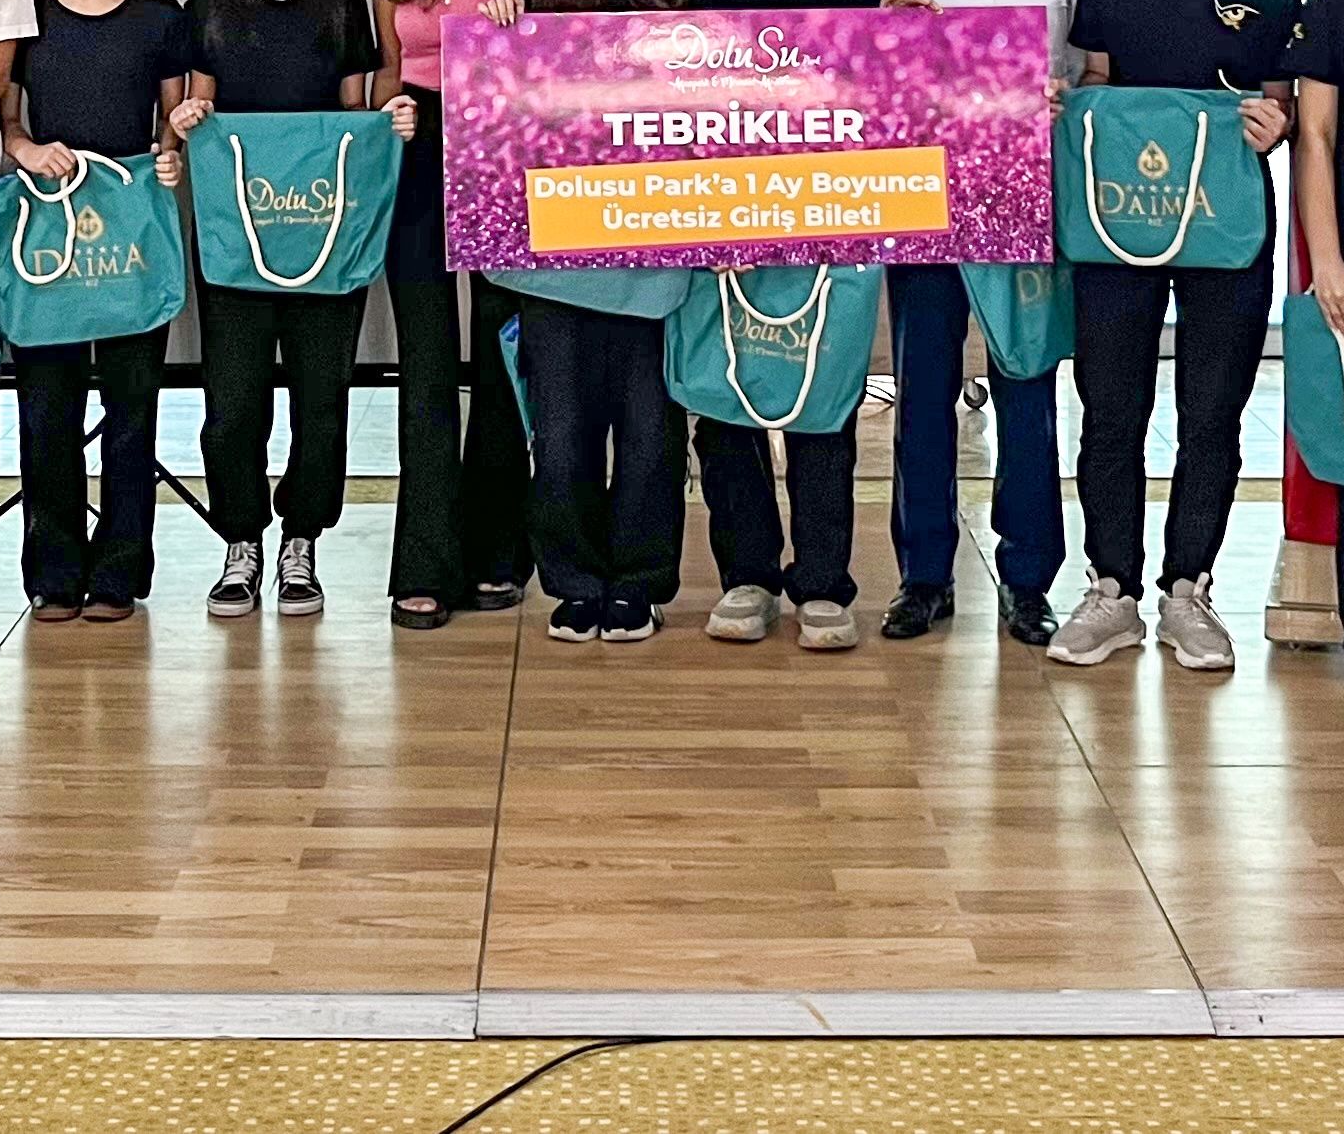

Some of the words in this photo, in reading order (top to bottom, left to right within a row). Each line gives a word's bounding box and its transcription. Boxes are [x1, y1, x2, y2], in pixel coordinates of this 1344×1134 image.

[603, 100, 864, 146] TEBRİKLER
[534, 175, 636, 199] Dolusu
[745, 173, 756, 194] 1
[764, 172, 803, 200] Ay
[811, 172, 941, 199] Boyunca
[602, 202, 722, 230] Ücretsiz
[729, 202, 795, 233] Giriş
[803, 202, 881, 227] Bileti
